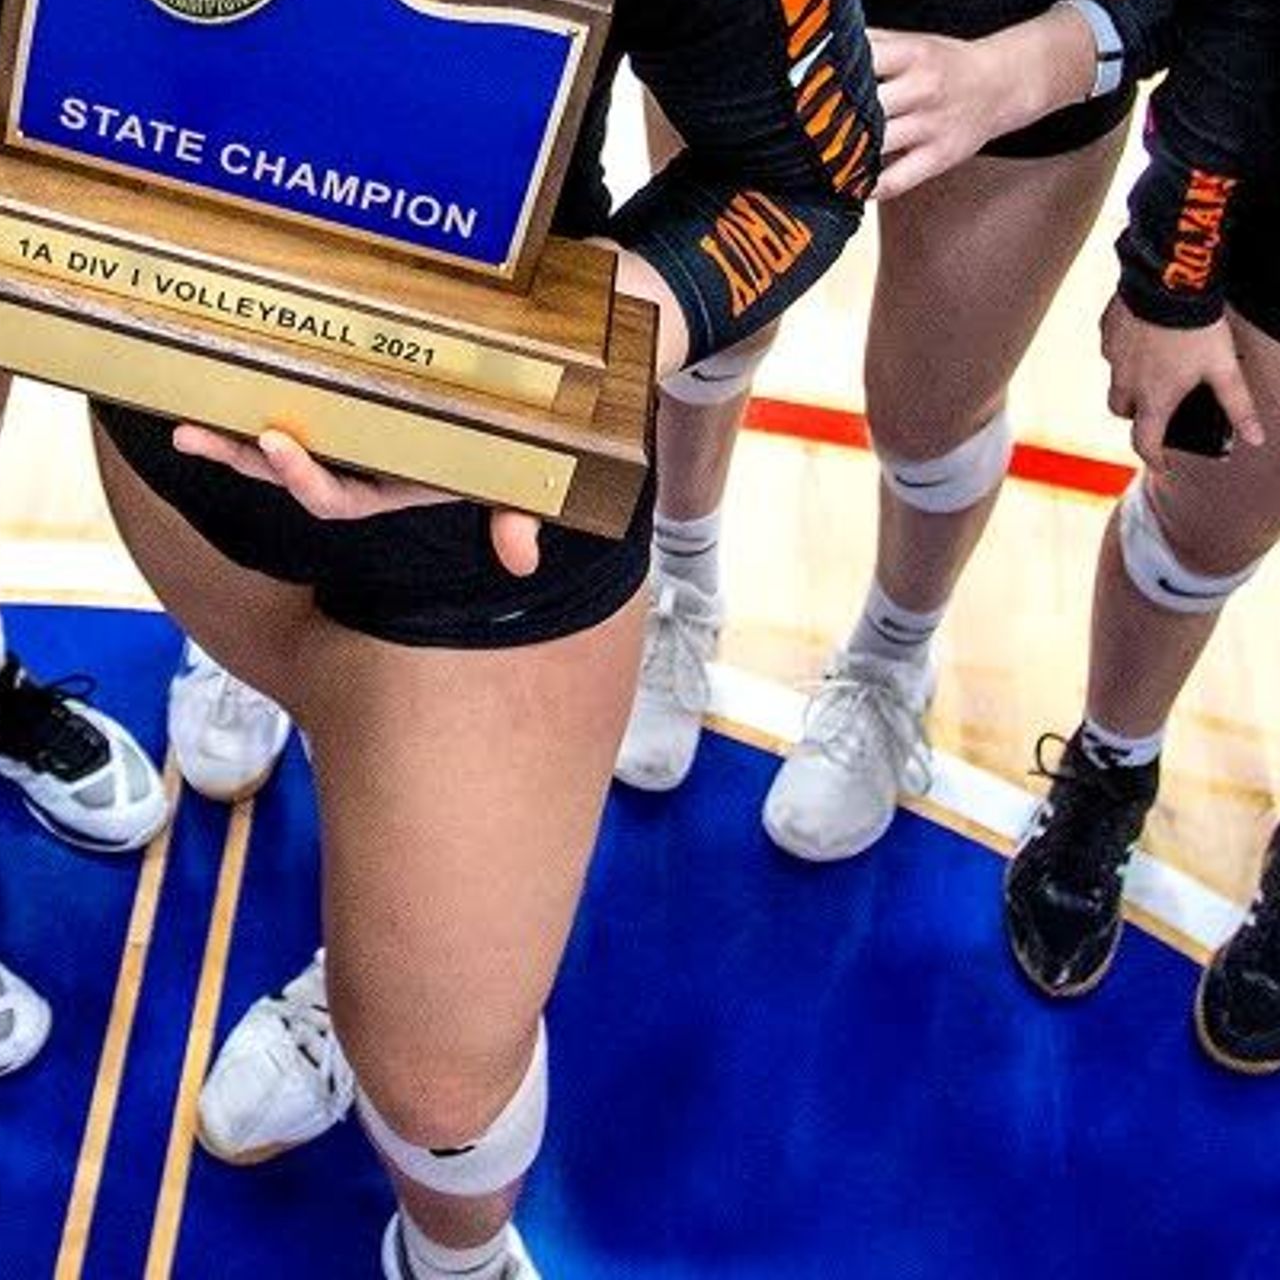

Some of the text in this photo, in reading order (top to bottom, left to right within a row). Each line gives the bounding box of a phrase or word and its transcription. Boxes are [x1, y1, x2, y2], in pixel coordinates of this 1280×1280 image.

[59, 97, 479, 238] STATE CHAMPION
[17, 237, 54, 264] 1A
[66, 252, 119, 281] DIV
[155, 275, 357, 347] VOLLEYBALL
[371, 333, 437, 368] 2021
